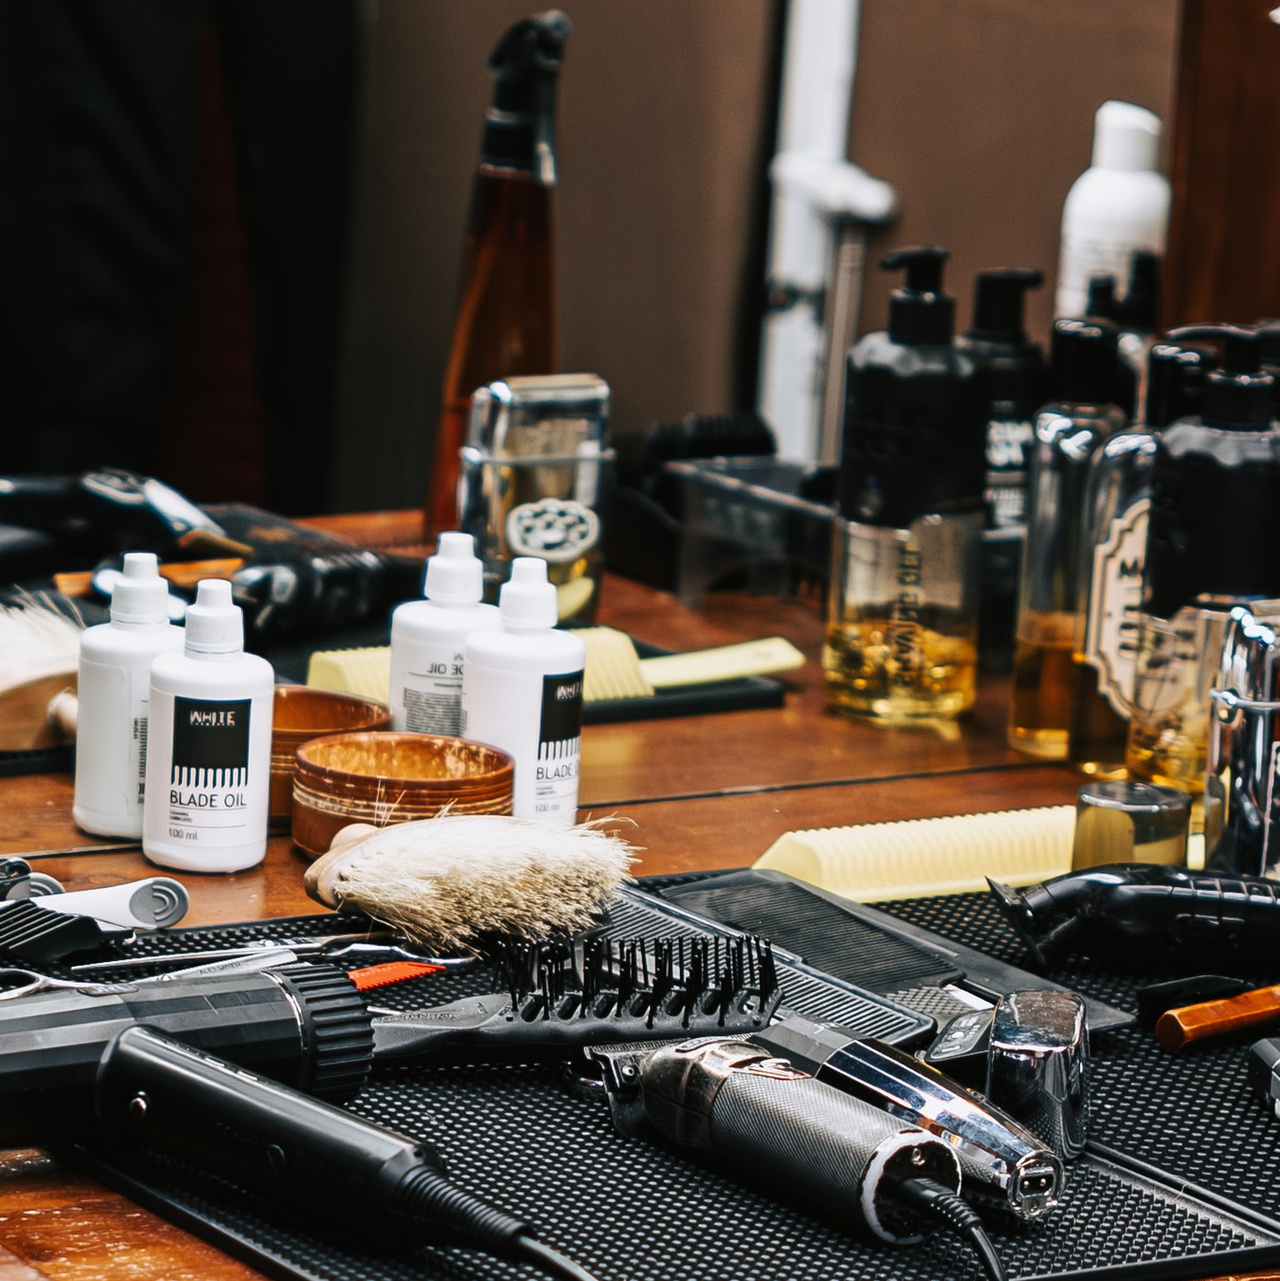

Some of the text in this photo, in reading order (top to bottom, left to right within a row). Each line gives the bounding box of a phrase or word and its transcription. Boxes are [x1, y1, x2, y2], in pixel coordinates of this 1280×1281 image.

[189, 710, 237, 726] WHITE
[535, 763, 573, 781] BLADE
[169, 789, 248, 808] BLADE OIL
